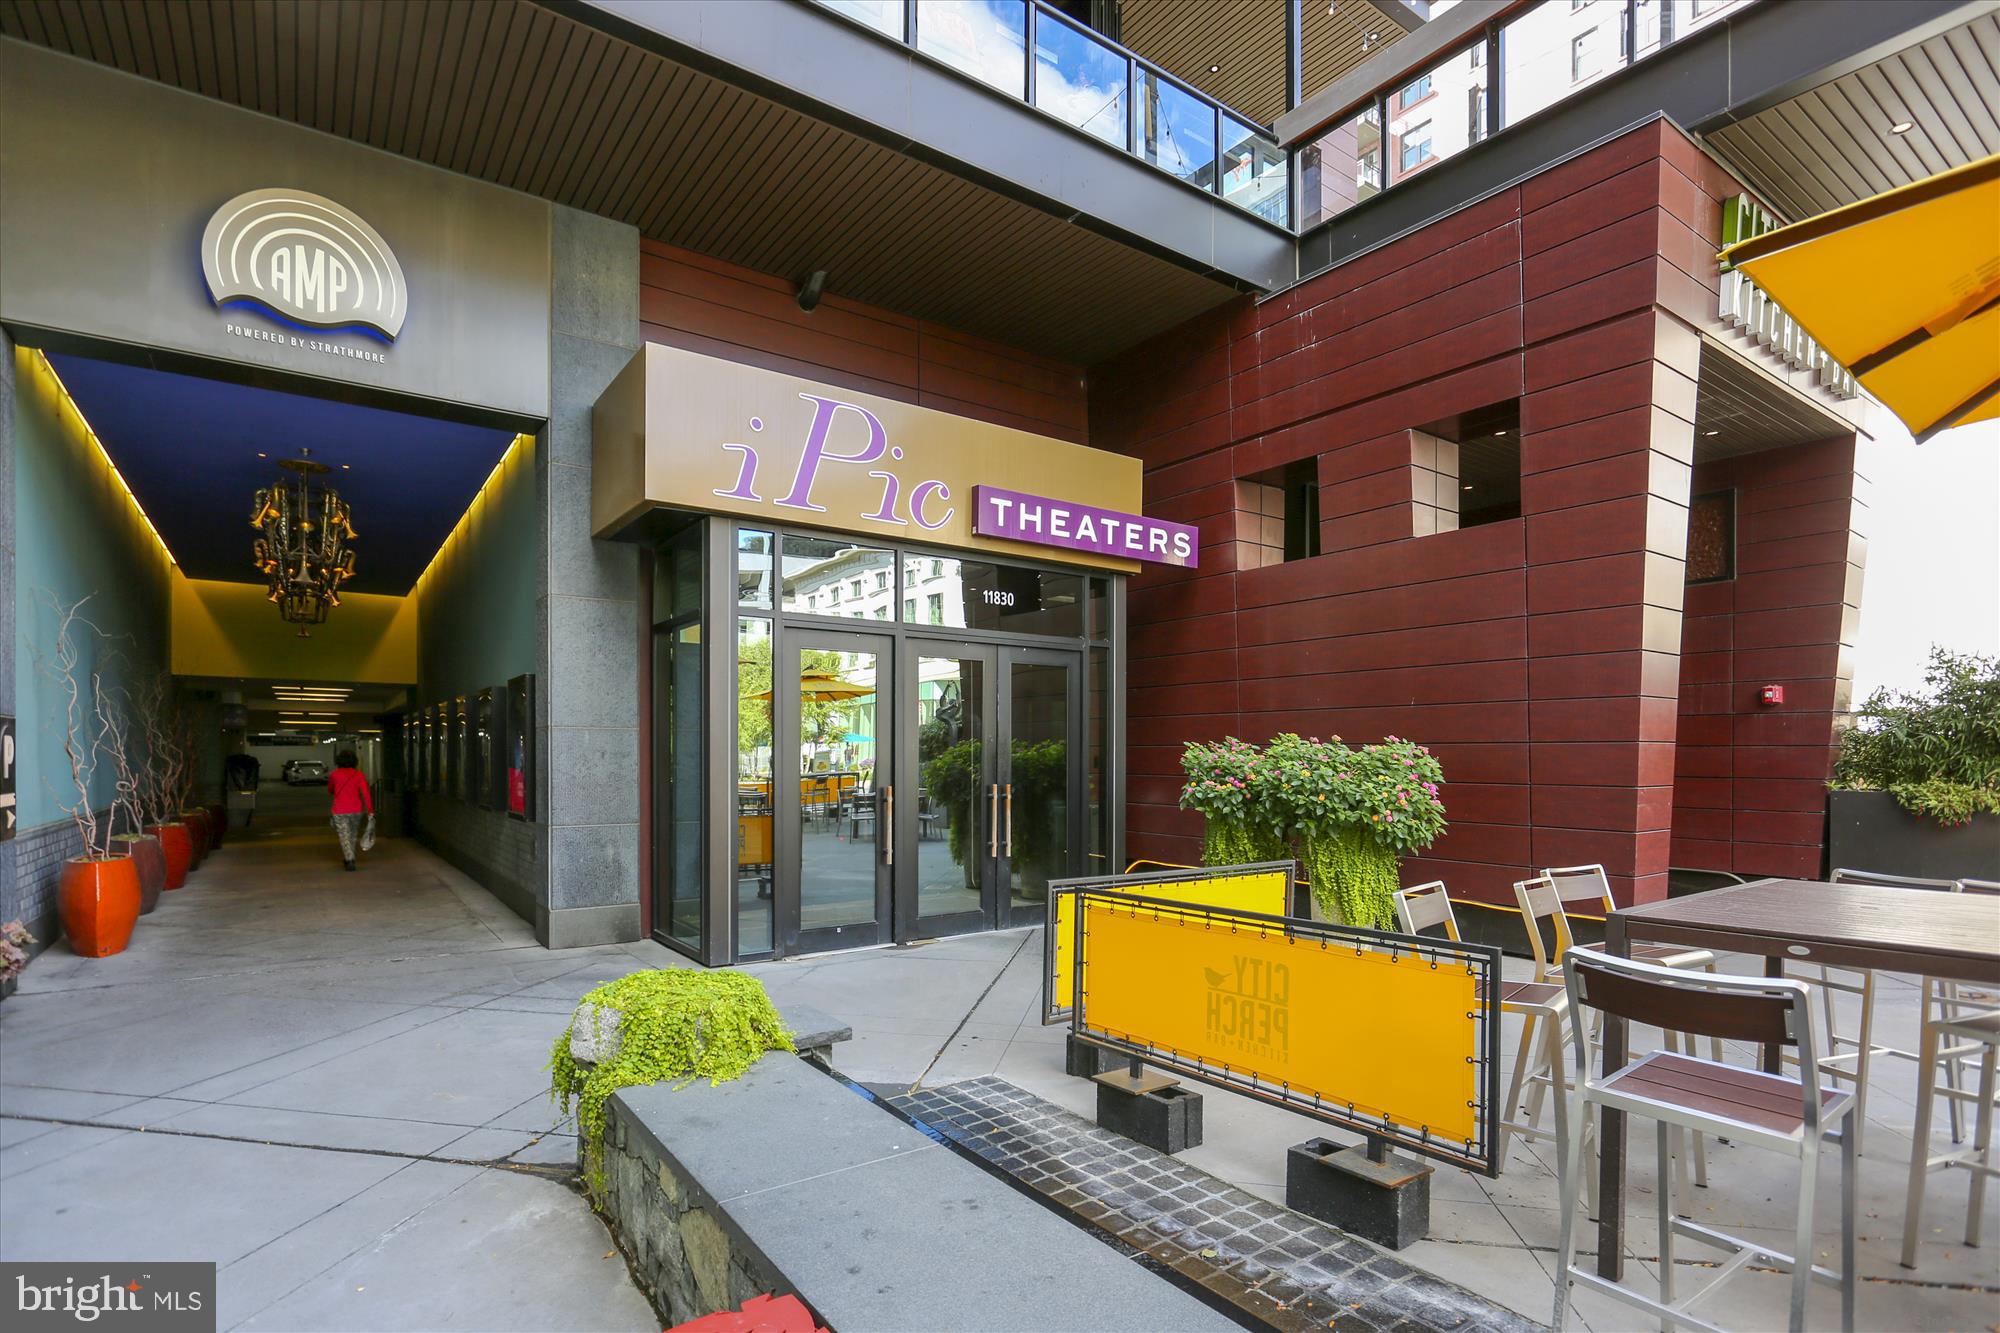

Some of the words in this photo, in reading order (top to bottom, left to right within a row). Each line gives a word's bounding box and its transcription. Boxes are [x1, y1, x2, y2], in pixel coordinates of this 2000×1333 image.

[271, 244, 347, 313] AMP
[226, 323, 285, 345] POWERED
[290, 336, 305, 349] BY
[310, 341, 386, 364] STRATHMORE
[712, 391, 955, 530] iPic
[989, 497, 1193, 559] THEATERS
[982, 589, 1015, 608] 11830
